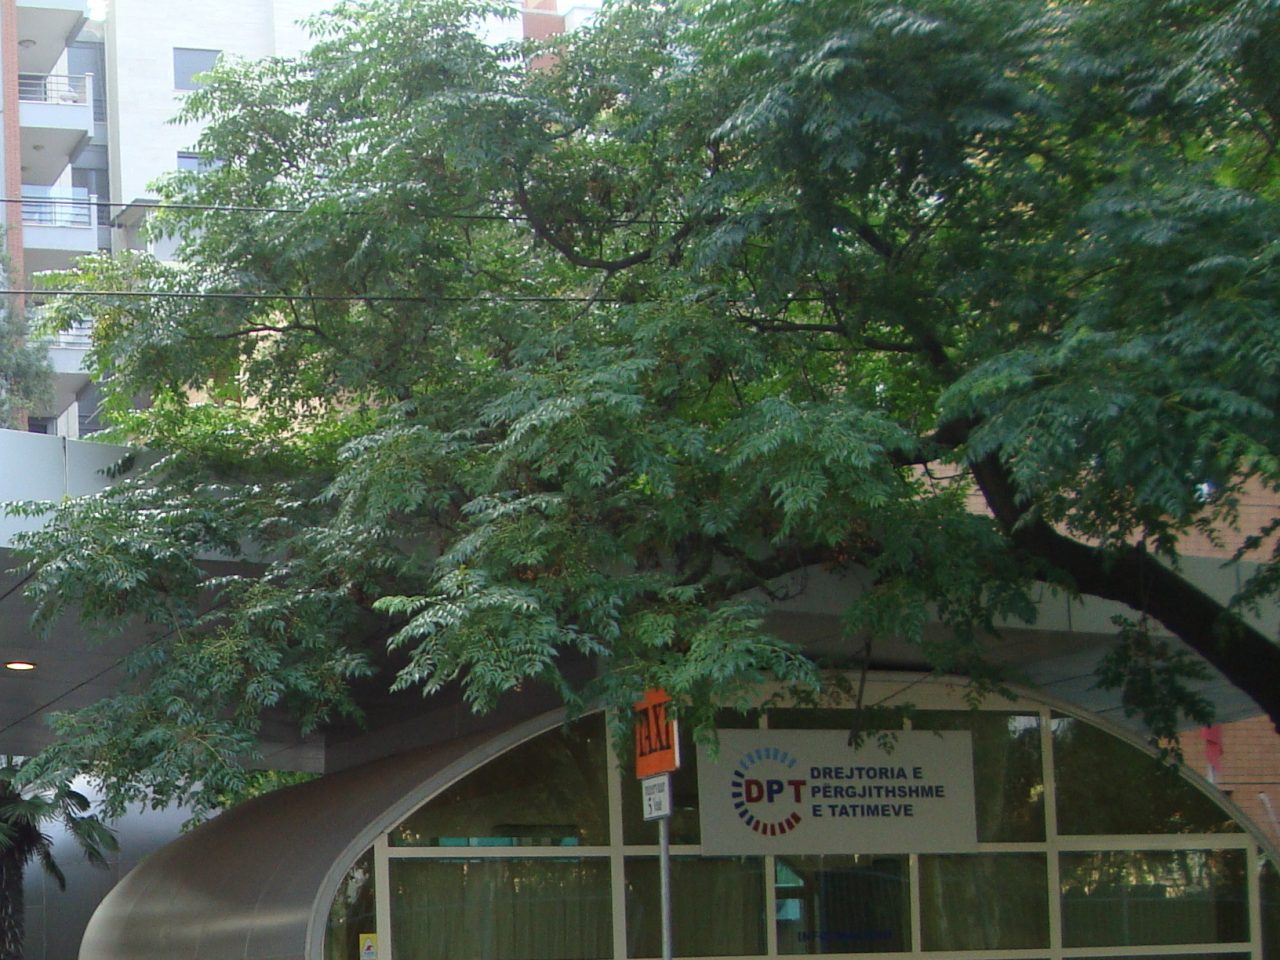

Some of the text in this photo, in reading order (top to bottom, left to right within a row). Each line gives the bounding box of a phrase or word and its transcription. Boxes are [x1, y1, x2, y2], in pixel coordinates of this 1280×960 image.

[637, 703, 672, 757] TAXI
[810, 767, 923, 780] DREJTORIA E
[744, 779, 807, 803] DPT
[811, 783, 945, 798] PËRGJITHSHME
[812, 804, 914, 817] E TATIMEVE
